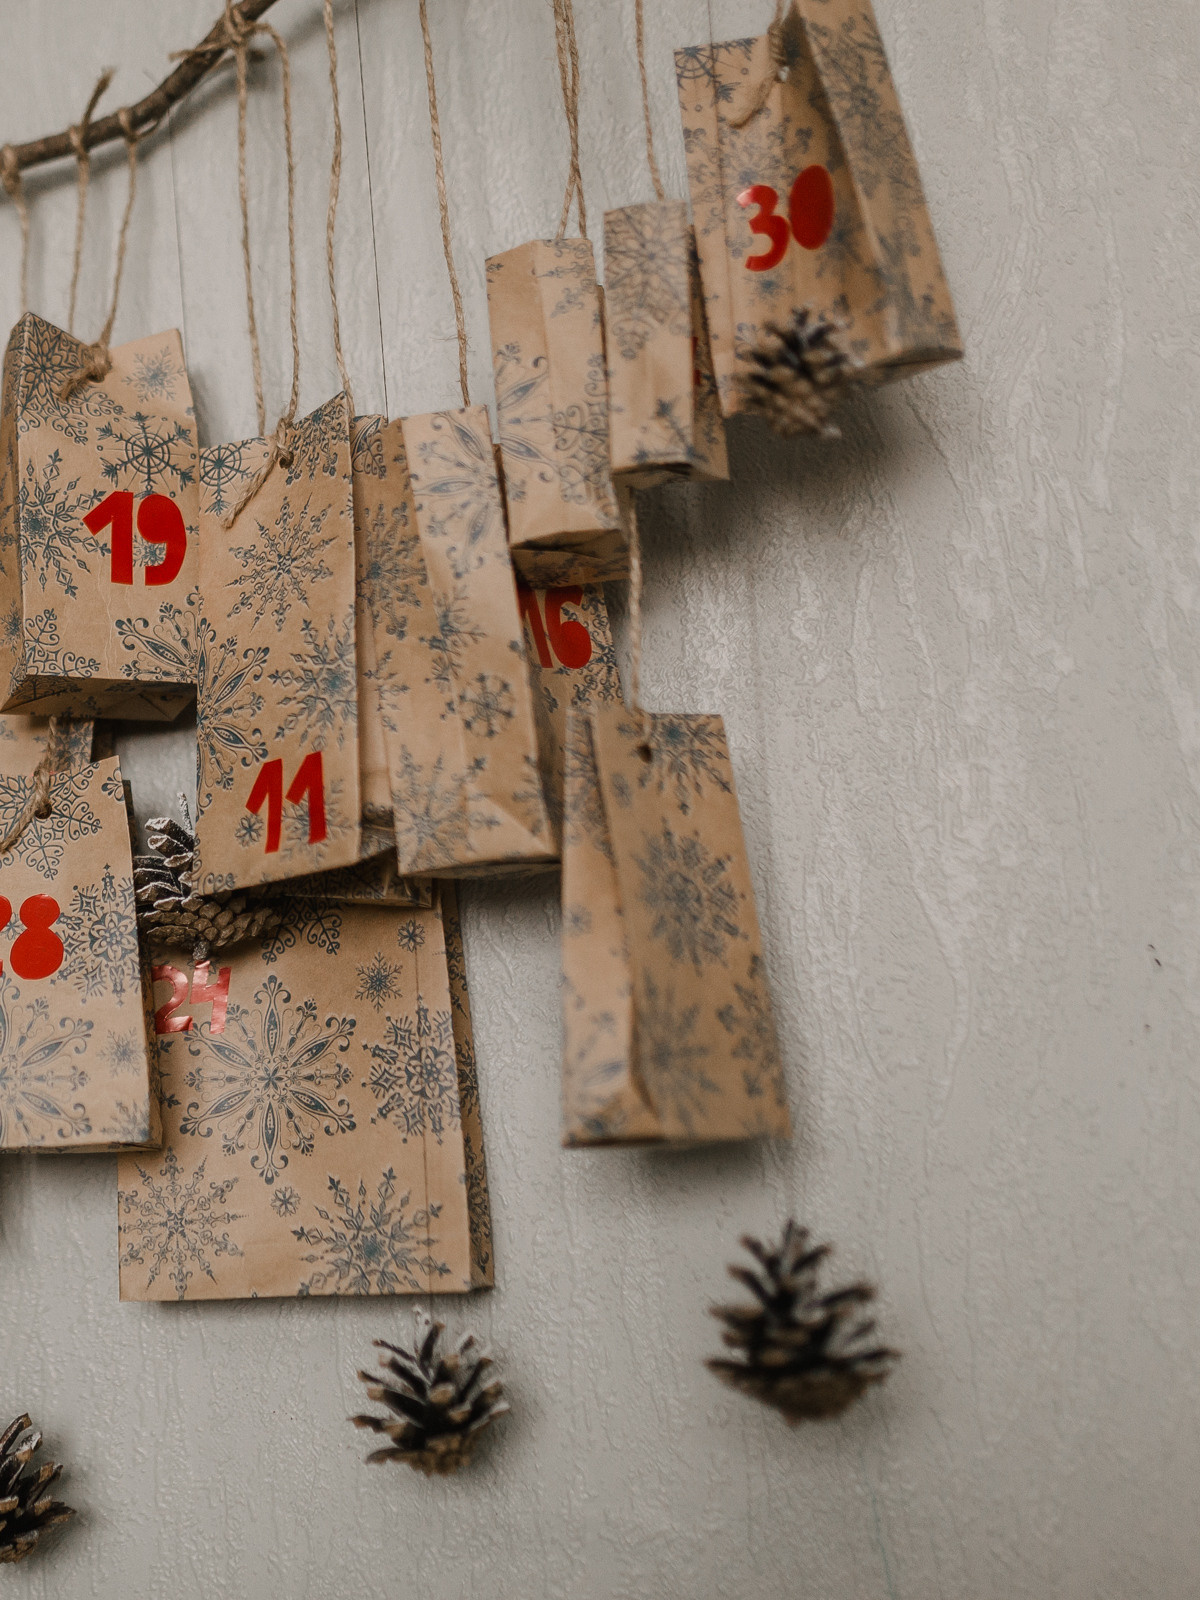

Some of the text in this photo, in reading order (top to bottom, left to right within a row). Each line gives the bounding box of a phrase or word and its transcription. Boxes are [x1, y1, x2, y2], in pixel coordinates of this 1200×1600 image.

[737, 163, 834, 272] 30
[82, 490, 188, 586] 19
[245, 750, 328, 855] 11
[151, 960, 232, 1035] 24
